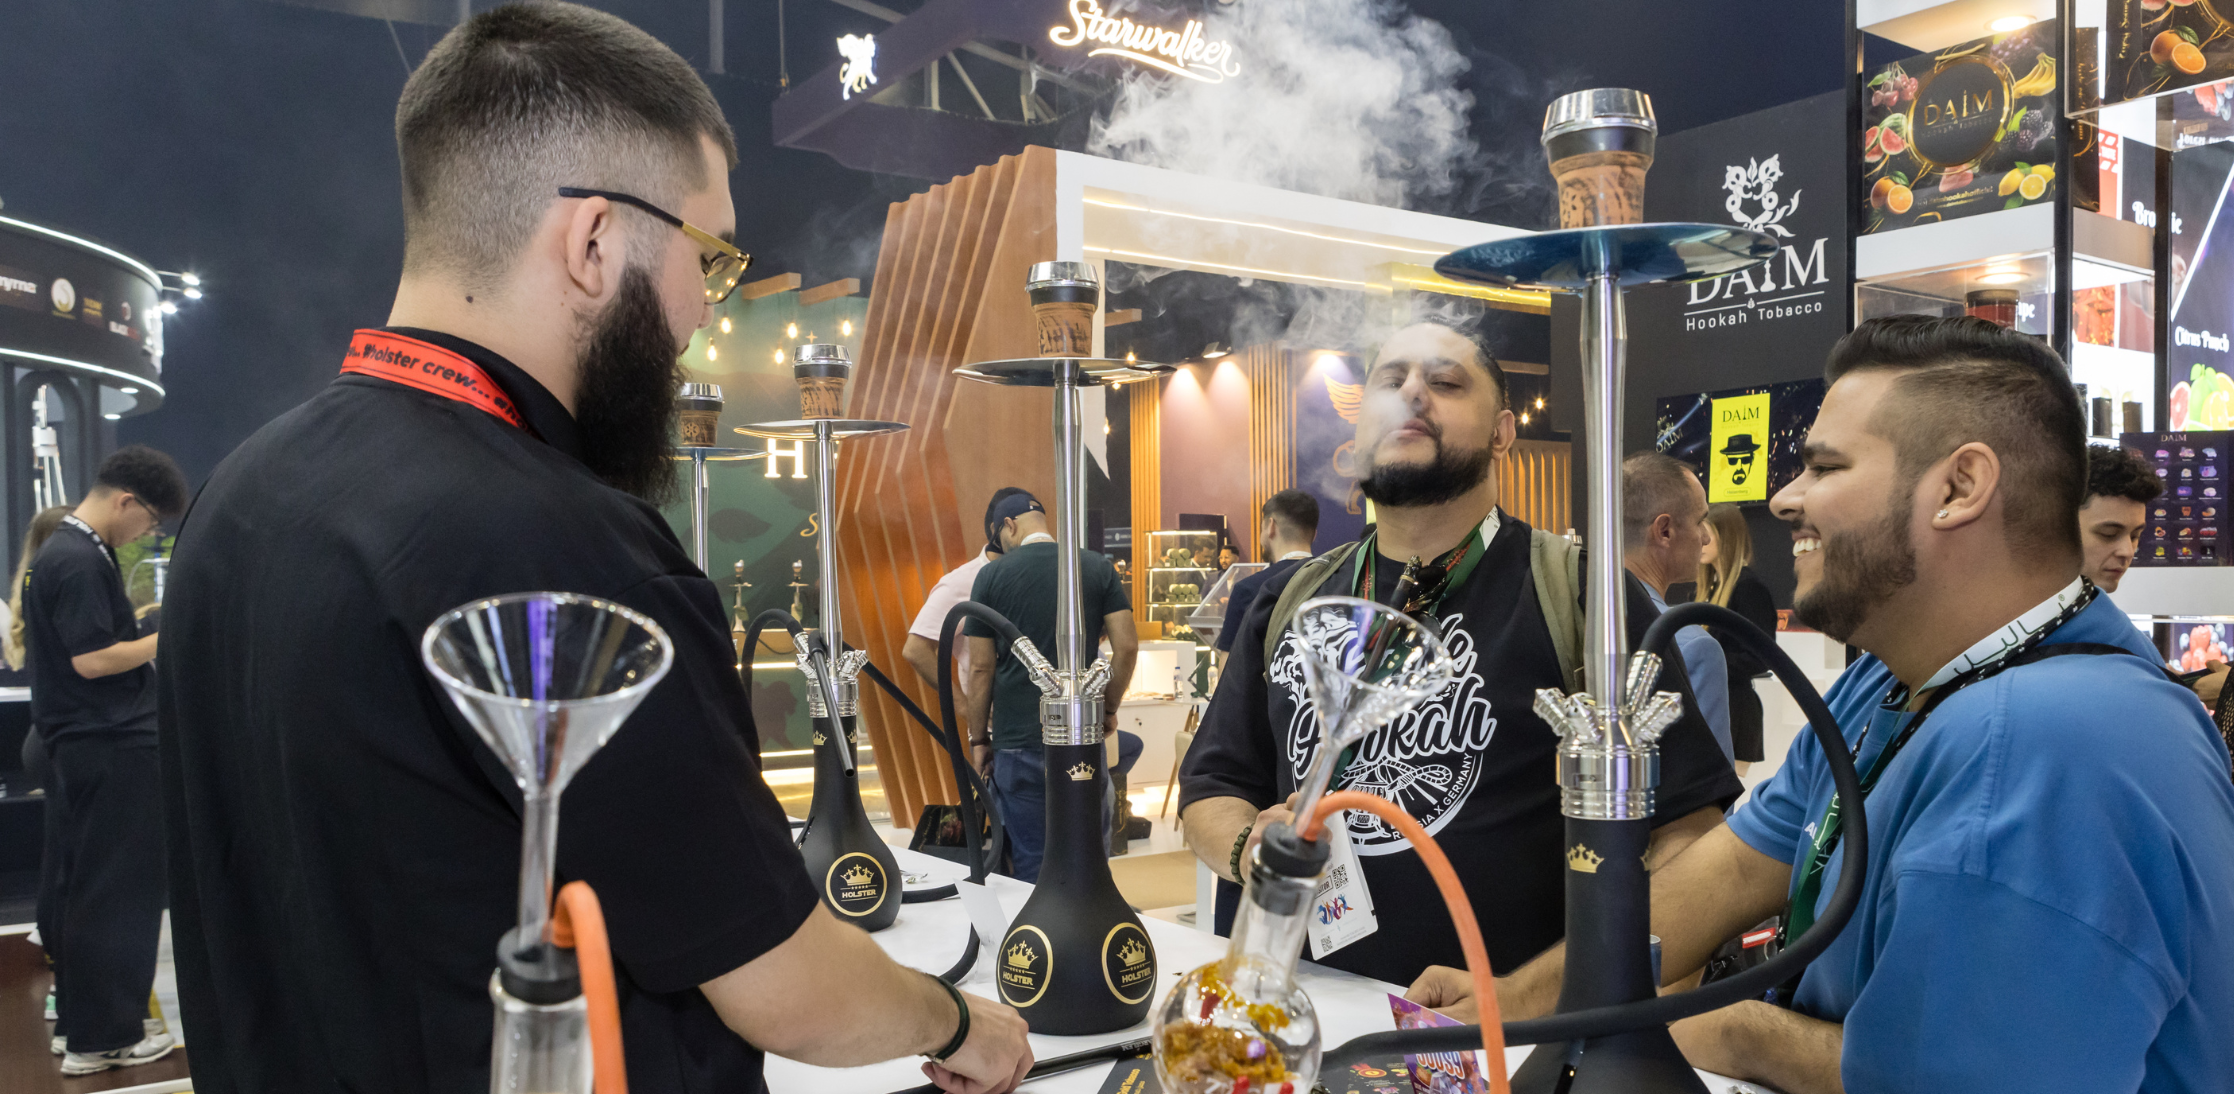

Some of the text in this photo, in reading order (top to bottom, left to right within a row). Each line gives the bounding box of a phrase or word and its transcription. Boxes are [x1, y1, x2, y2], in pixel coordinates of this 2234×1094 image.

[1050, 0, 1240, 77] Starwalker
[1924, 89, 1994, 126] DAIM
[1686, 302, 1822, 331] Hookah Tobacco
[1722, 405, 1760, 423] DAIM
[2161, 434, 2187, 442] DAIM
[1436, 807, 1444, 816] X
[1443, 752, 1474, 806] GERMANY
[841, 889, 877, 899] HOLSTER
[1002, 970, 1034, 986] HOLSTER
[1121, 967, 1152, 983] HOLSTER
